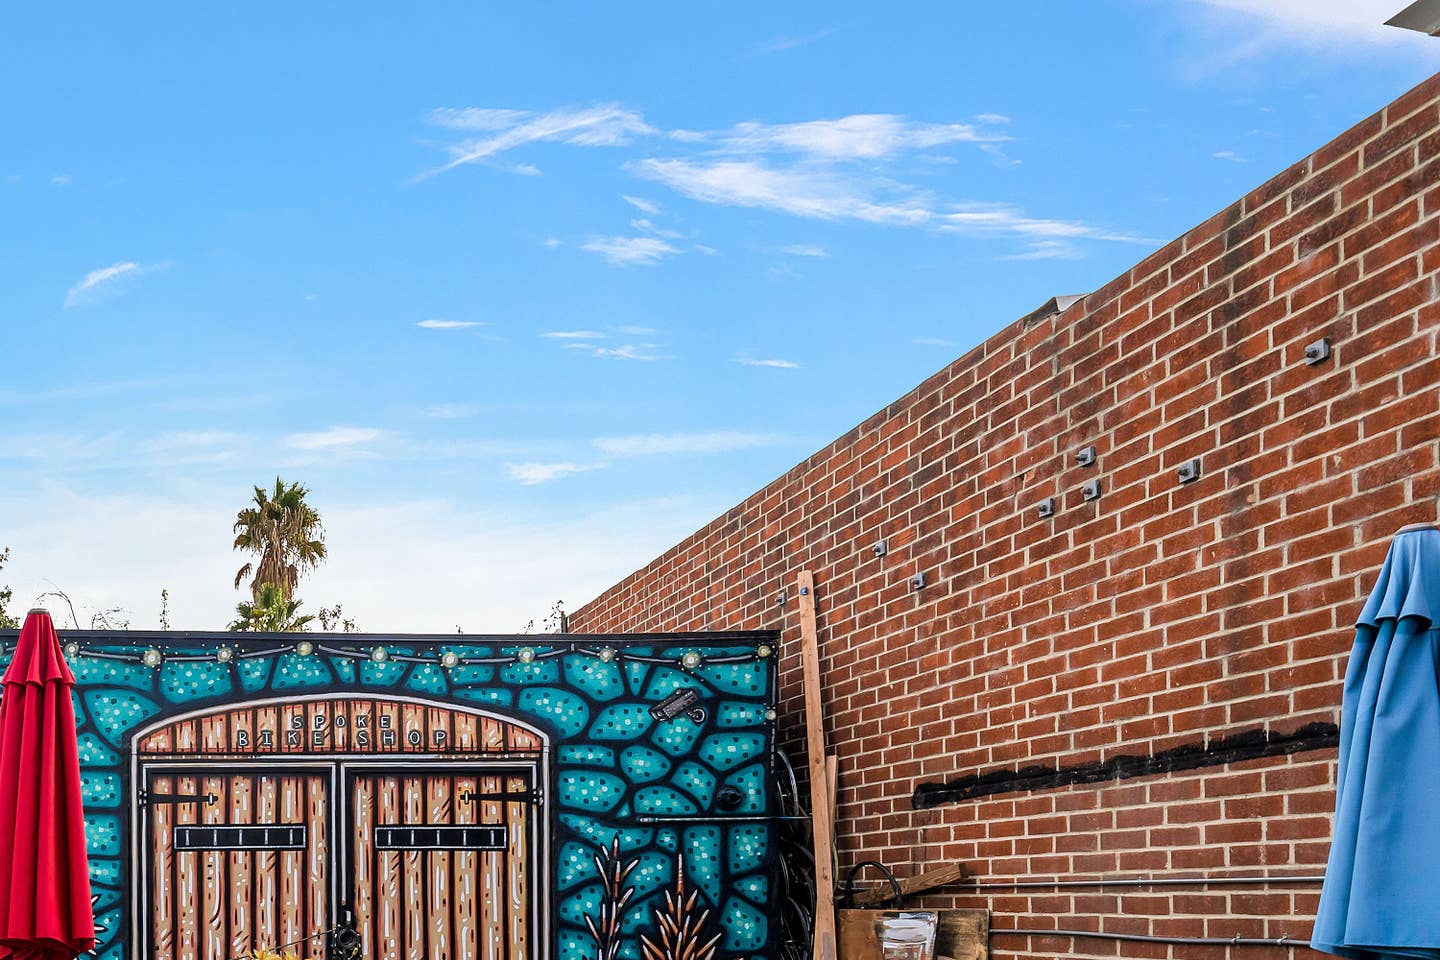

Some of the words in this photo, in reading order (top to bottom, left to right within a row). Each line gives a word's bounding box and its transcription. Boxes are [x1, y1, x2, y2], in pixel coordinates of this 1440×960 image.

[291, 715, 393, 730] SPOKE
[237, 730, 325, 747] BIKE
[356, 731, 447, 747] SHOP
